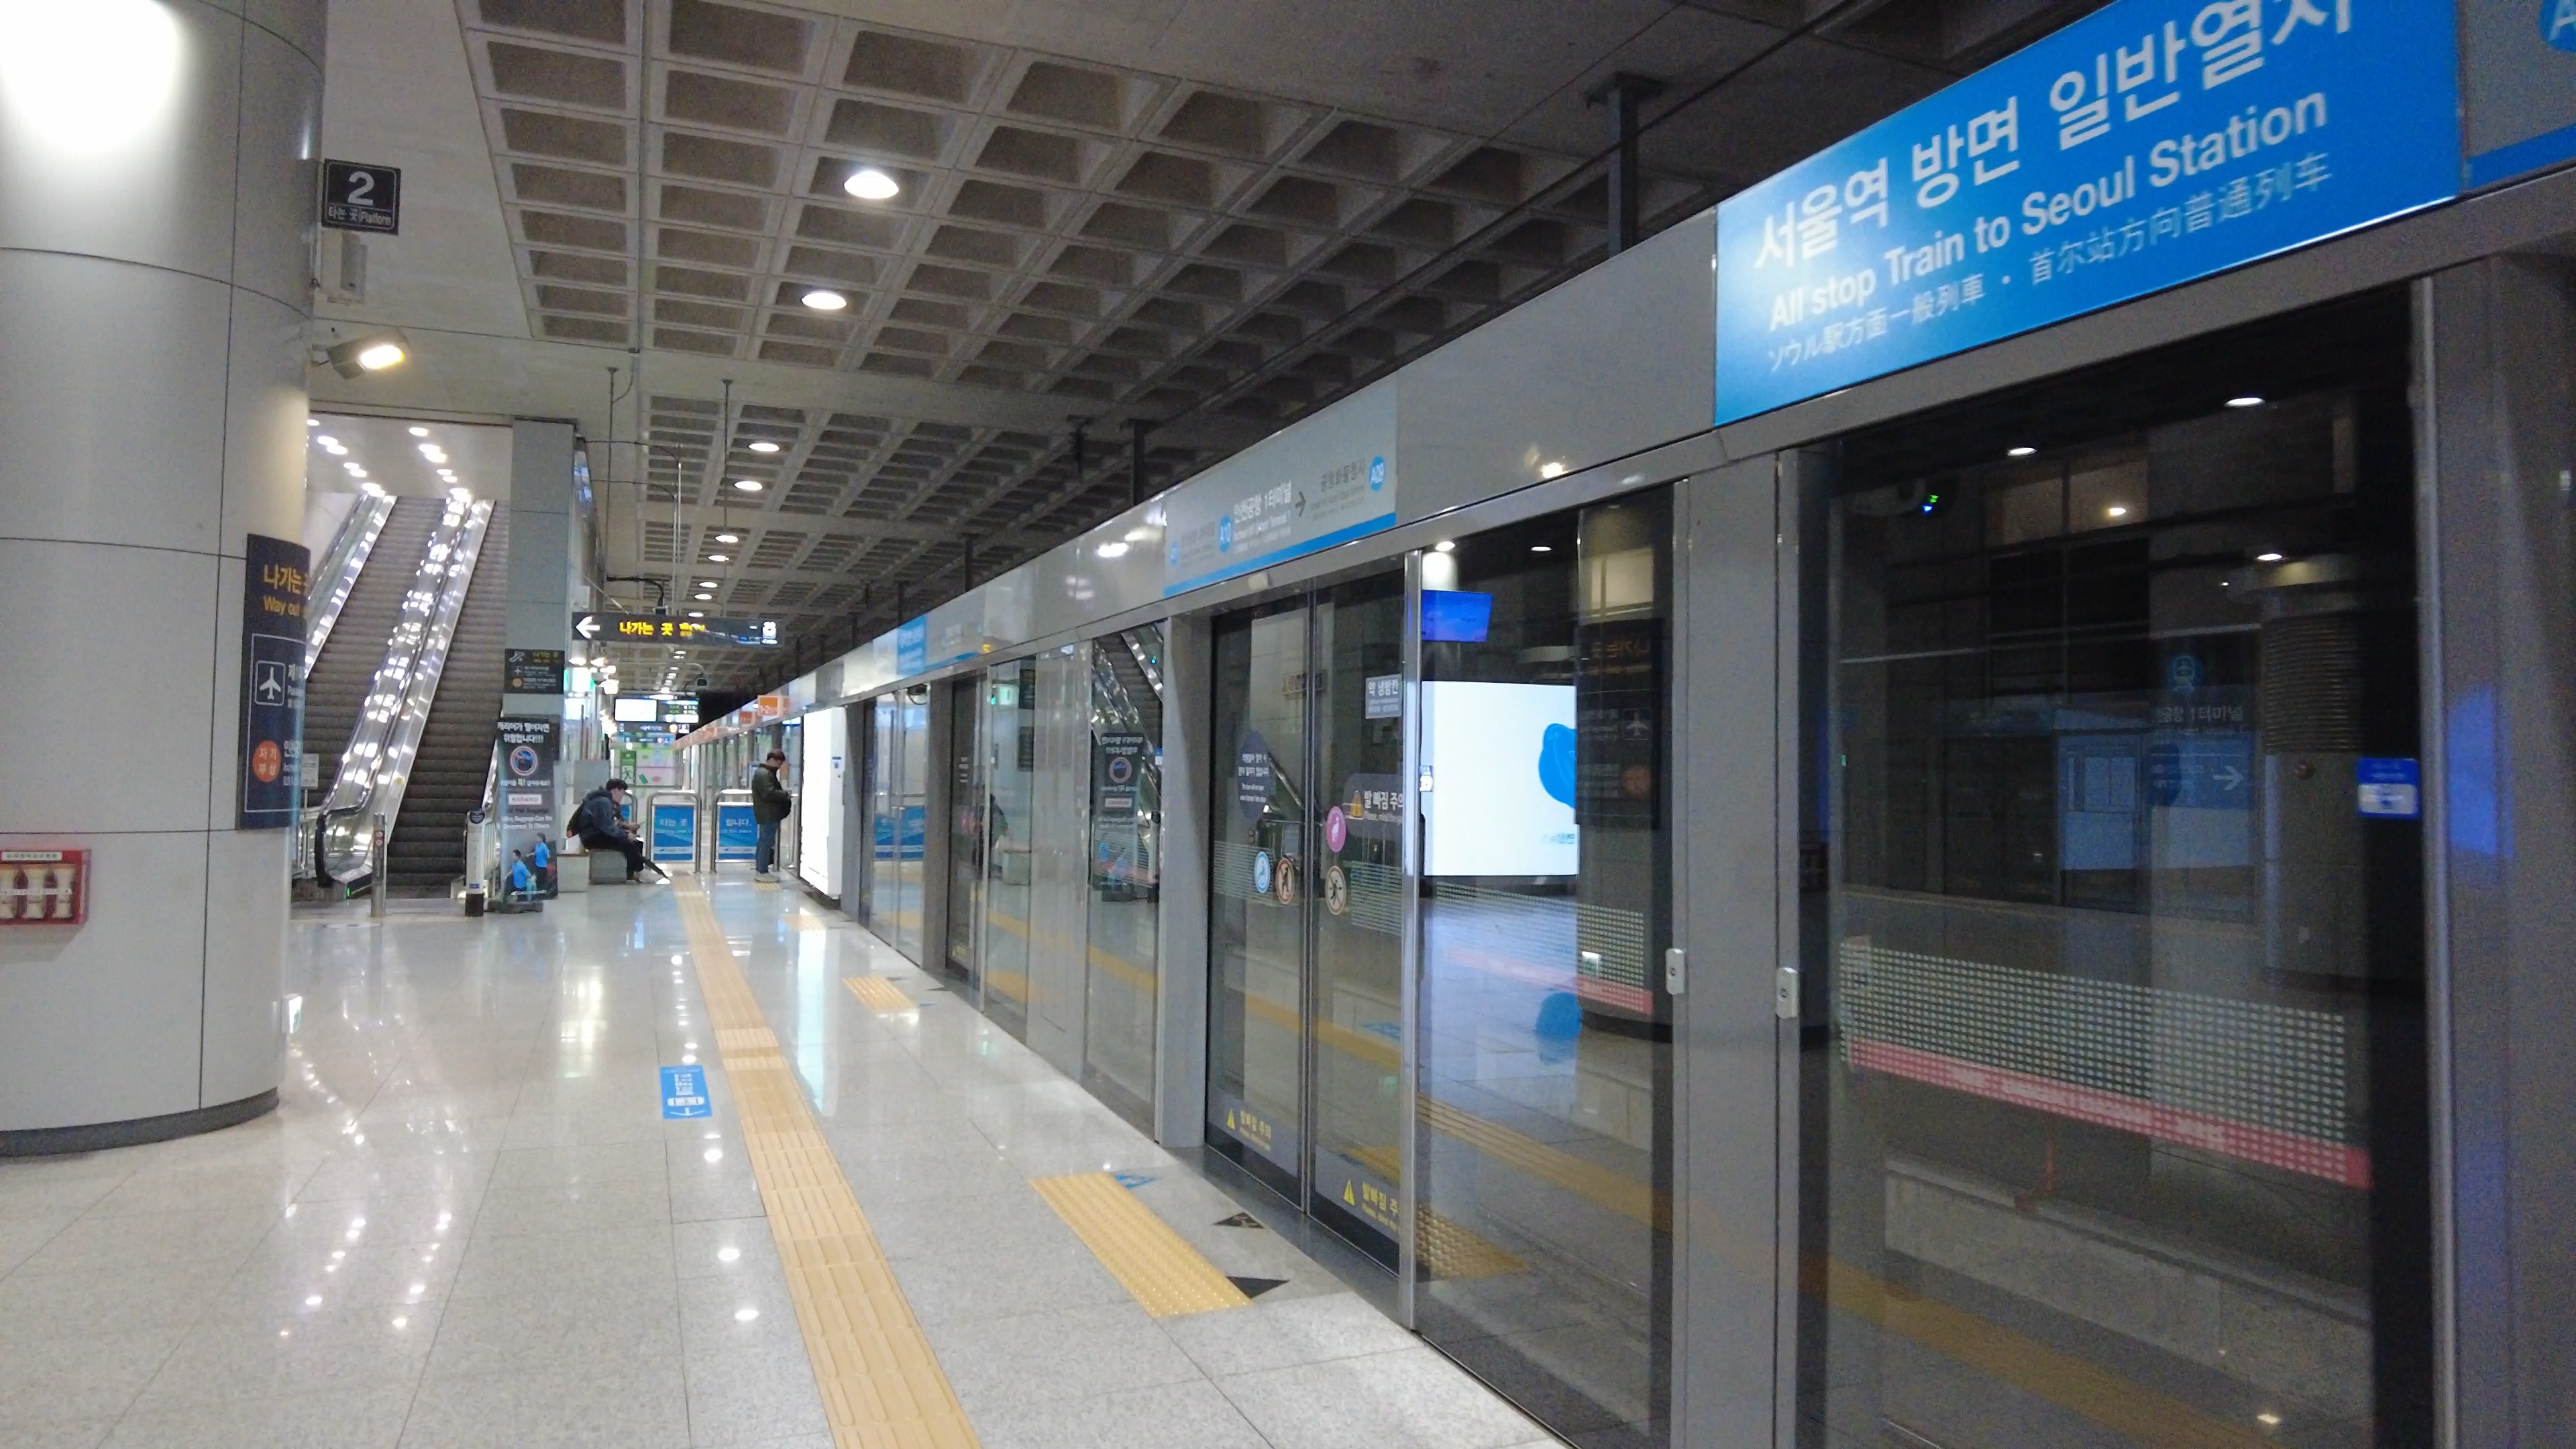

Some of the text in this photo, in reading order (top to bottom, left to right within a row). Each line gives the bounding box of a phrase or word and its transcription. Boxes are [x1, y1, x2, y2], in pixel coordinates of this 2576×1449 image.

[348, 171, 374, 205] 2
[1754, 156, 1888, 268] 서울역
[1912, 96, 2020, 209] 방면
[1770, 91, 2327, 331] All stop Train to Seoul Station
[263, 563, 302, 594] 나가는
[619, 621, 654, 636] 나가는
[660, 622, 674, 636] 곳
